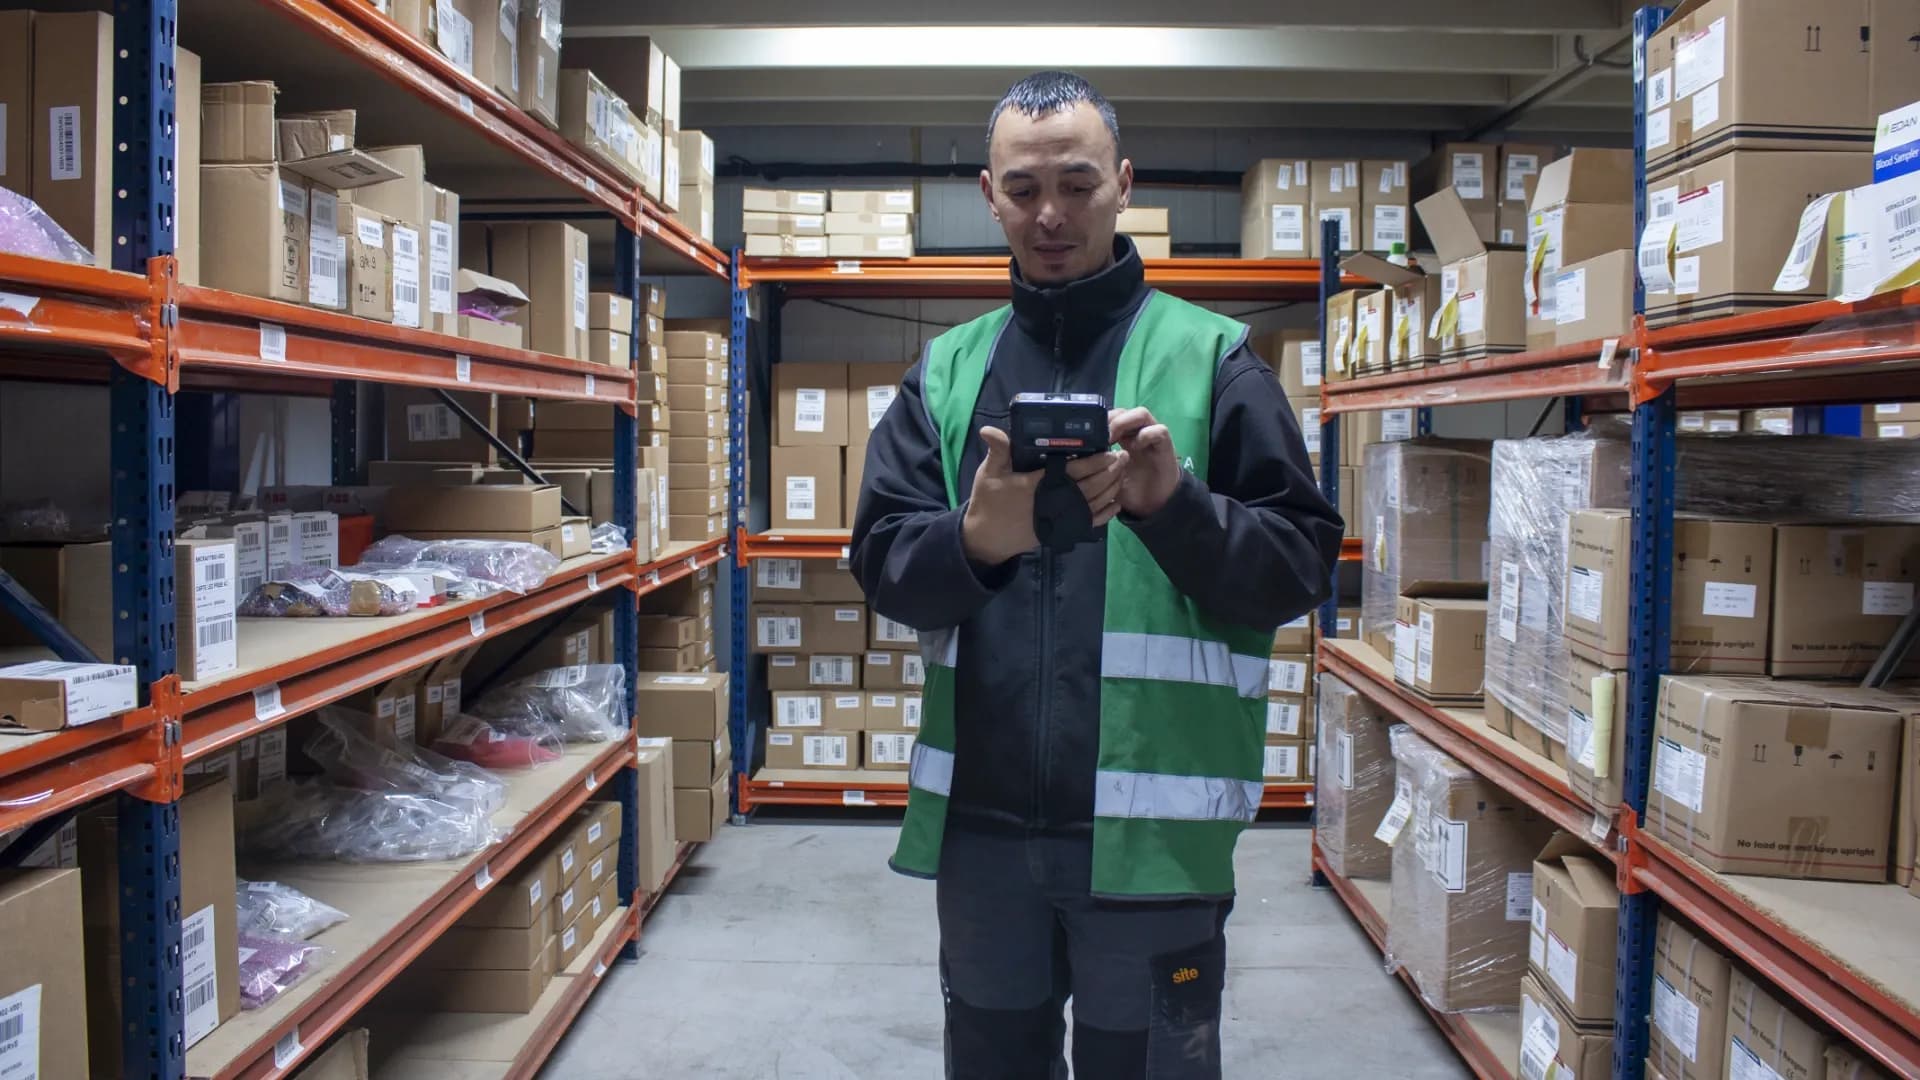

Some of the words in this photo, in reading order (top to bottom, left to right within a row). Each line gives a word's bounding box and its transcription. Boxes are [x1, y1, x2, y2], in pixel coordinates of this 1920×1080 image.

[1890, 116, 1918, 133] EDAN
[1875, 155, 1893, 171] Blood
[1894, 148, 1920, 164] Sampler
[328, 492, 349, 504] ABB
[1737, 839, 1751, 849] No
[1754, 840, 1775, 850] load
[1778, 842, 1791, 851] on
[1813, 842, 1838, 855] keep
[1840, 845, 1875, 858] upright
[1172, 967, 1198, 983] site
